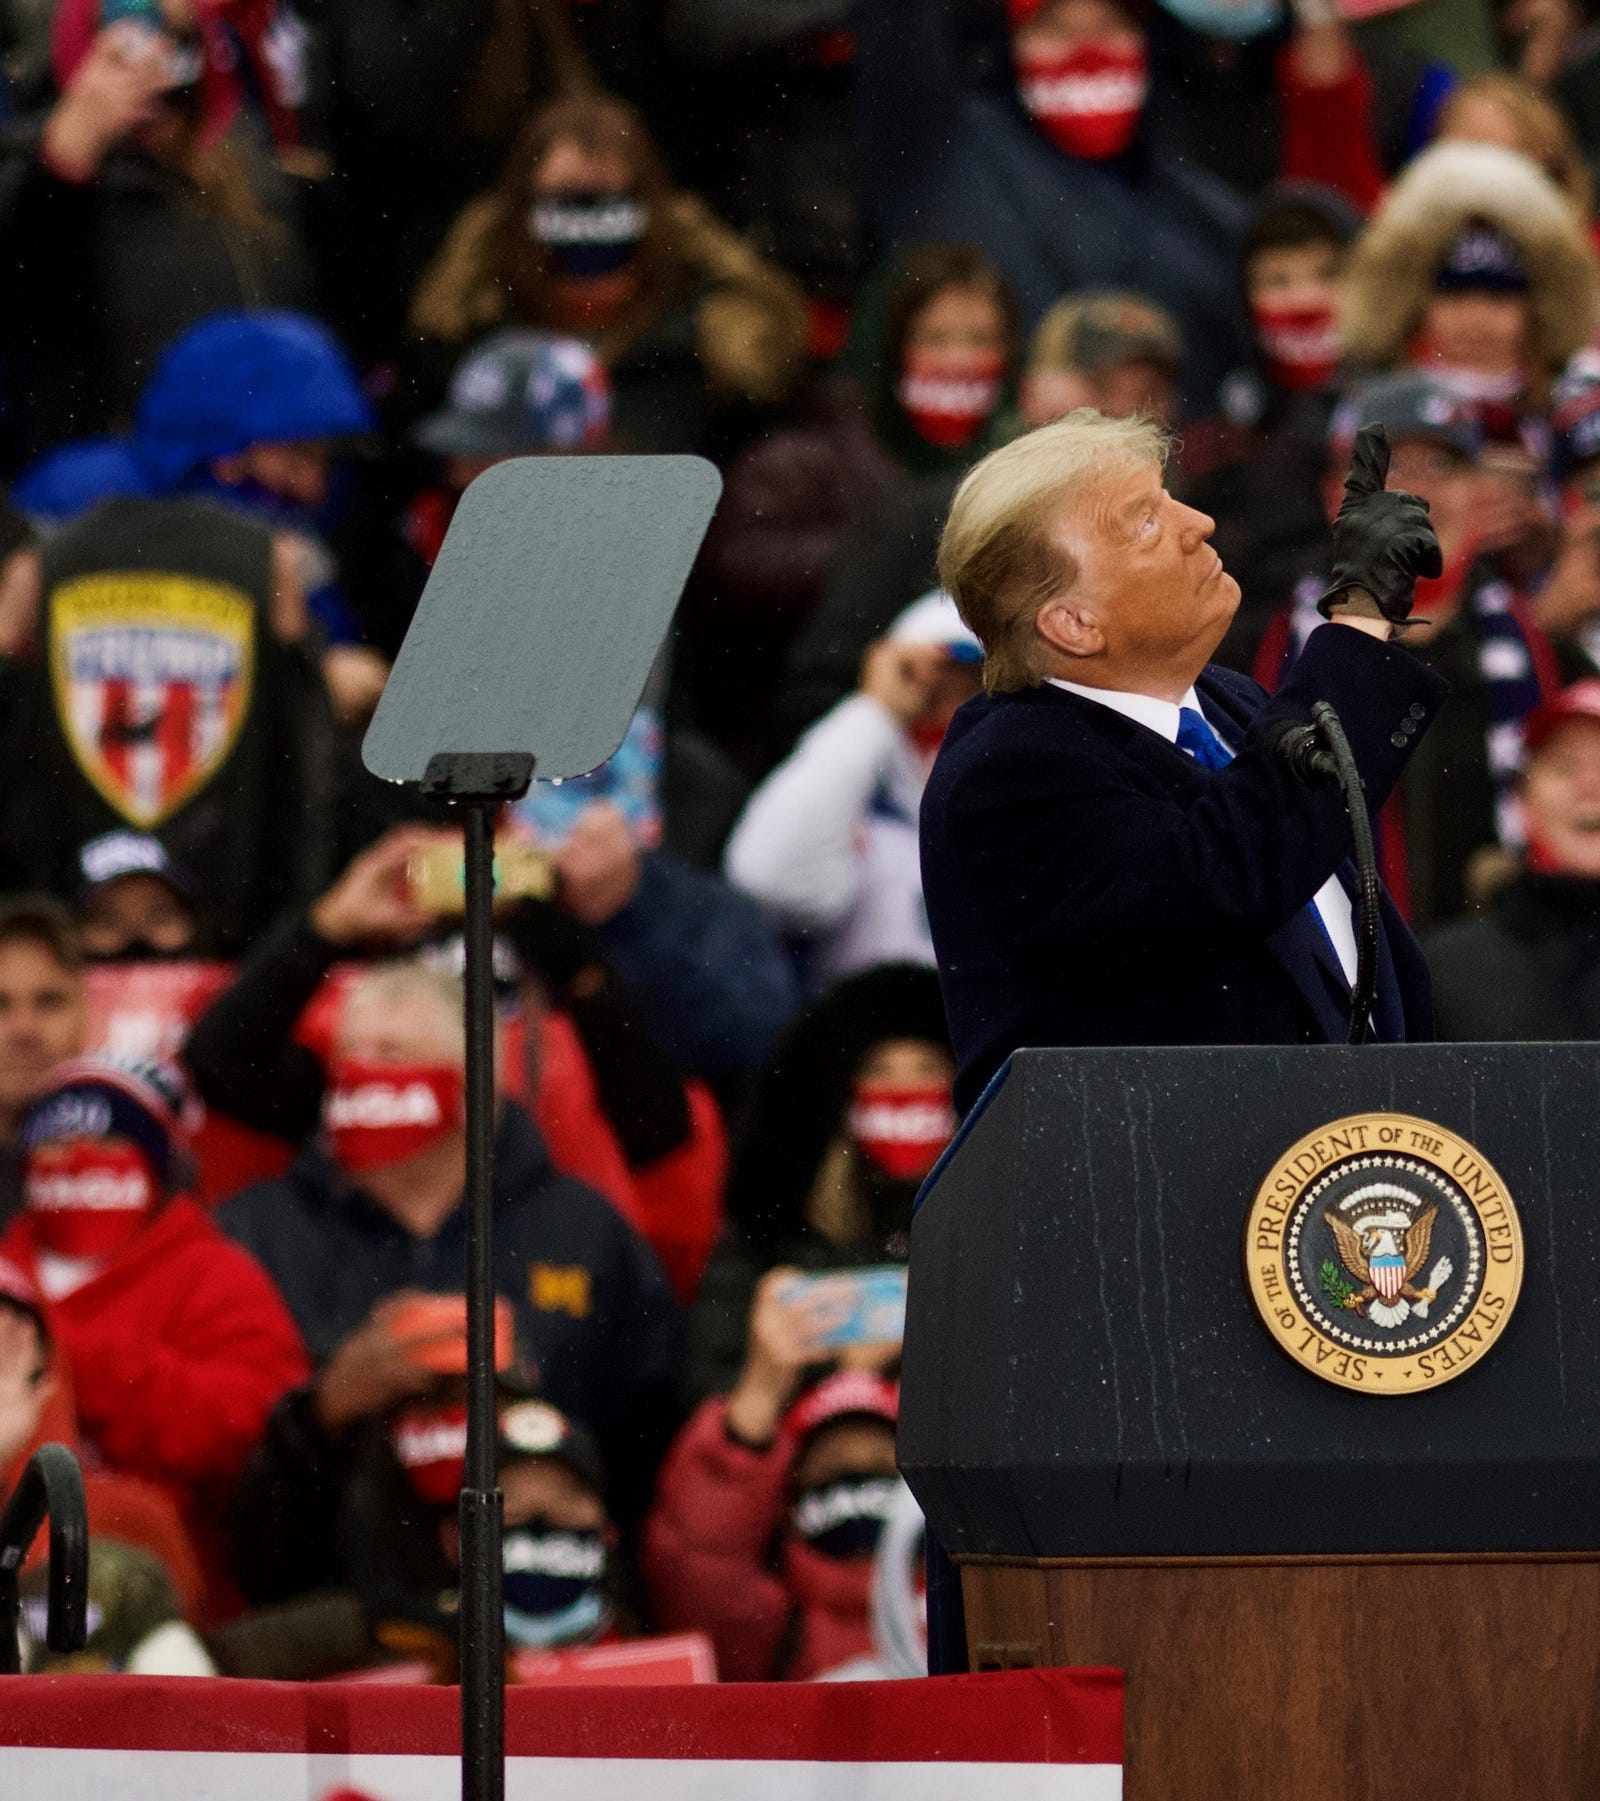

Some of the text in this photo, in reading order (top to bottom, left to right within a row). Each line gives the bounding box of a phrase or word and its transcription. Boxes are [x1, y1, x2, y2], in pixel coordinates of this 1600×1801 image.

[1256, 1125, 1513, 1381] SEAL OF THE PRESIDENT OF THE UNITED STATES
